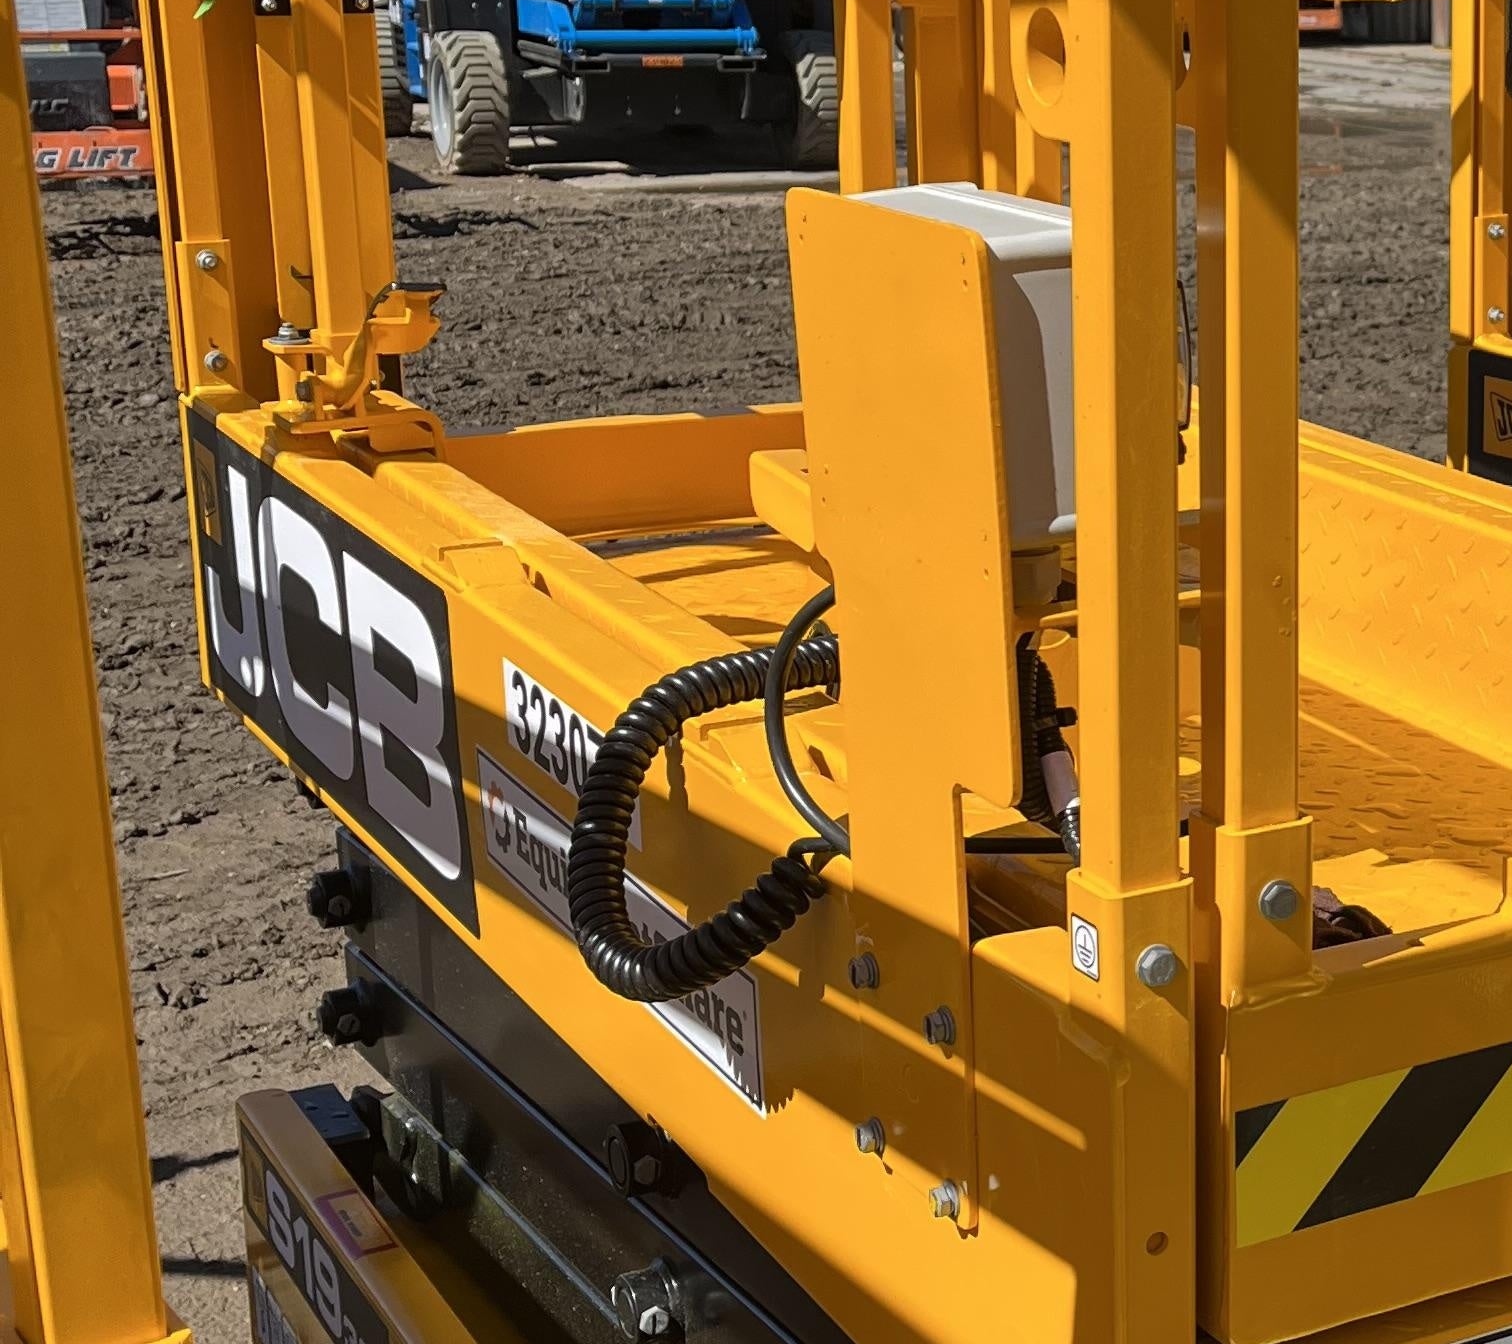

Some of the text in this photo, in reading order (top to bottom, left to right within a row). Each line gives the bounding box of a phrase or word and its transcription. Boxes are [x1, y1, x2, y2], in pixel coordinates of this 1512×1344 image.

[67, 146, 139, 169] LIFT
[205, 464, 463, 882] JCB
[512, 669, 606, 799] 3230
